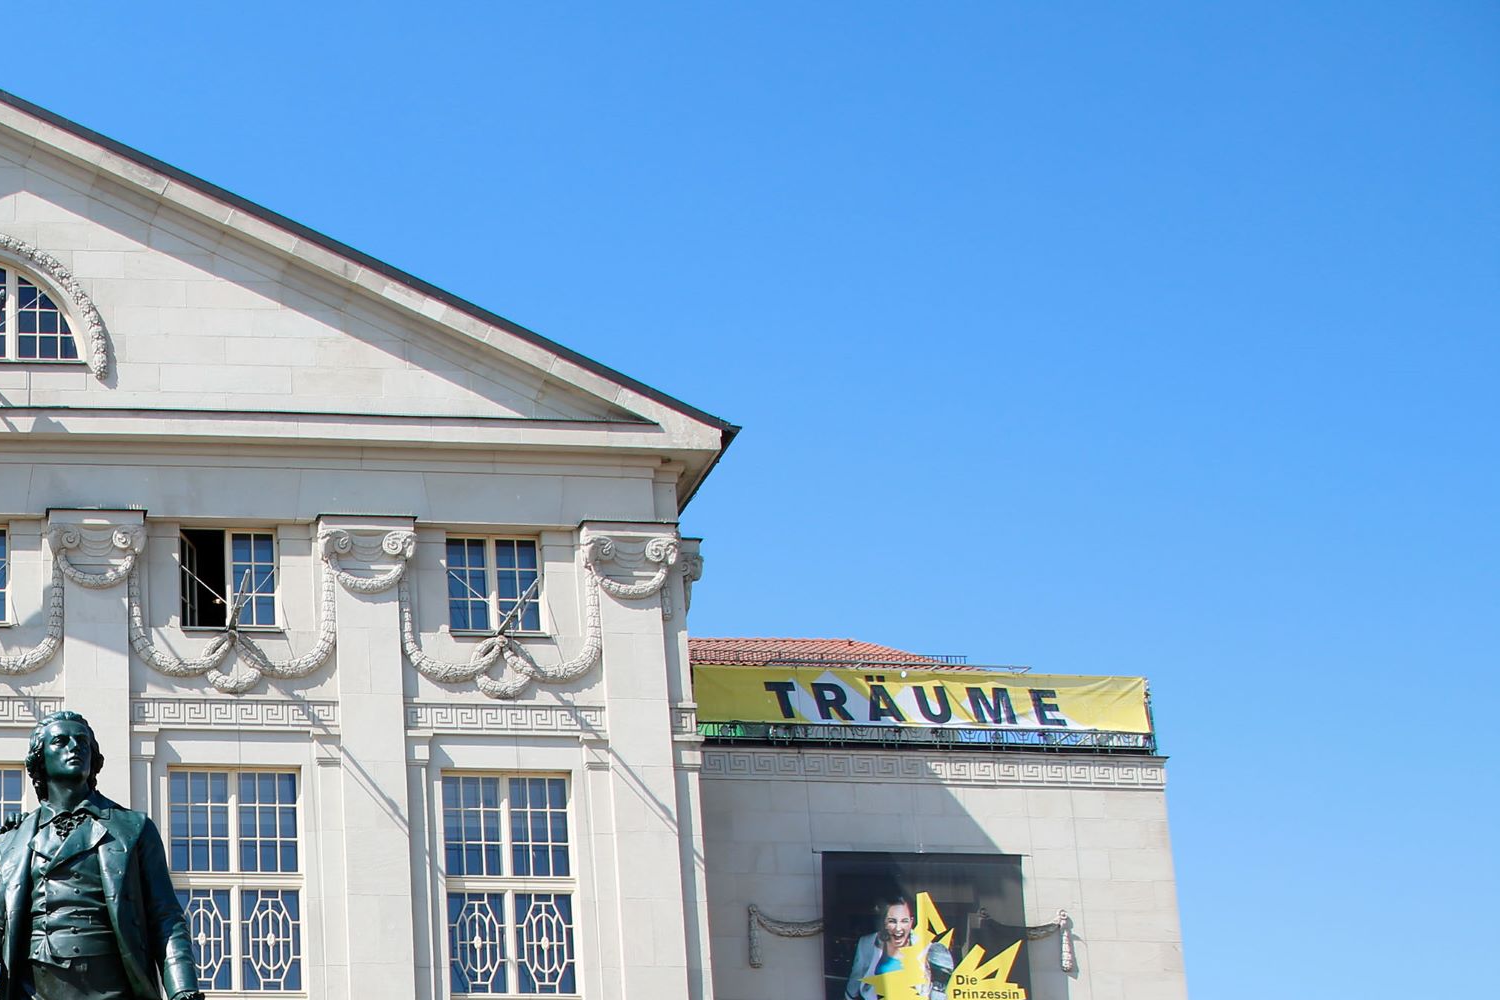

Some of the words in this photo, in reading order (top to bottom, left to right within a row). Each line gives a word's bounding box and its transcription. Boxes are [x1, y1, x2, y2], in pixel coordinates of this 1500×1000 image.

[763, 675, 1068, 727] TRÄUME
[955, 975, 978, 986] Die
[952, 989, 1020, 1000] Prinzessin
